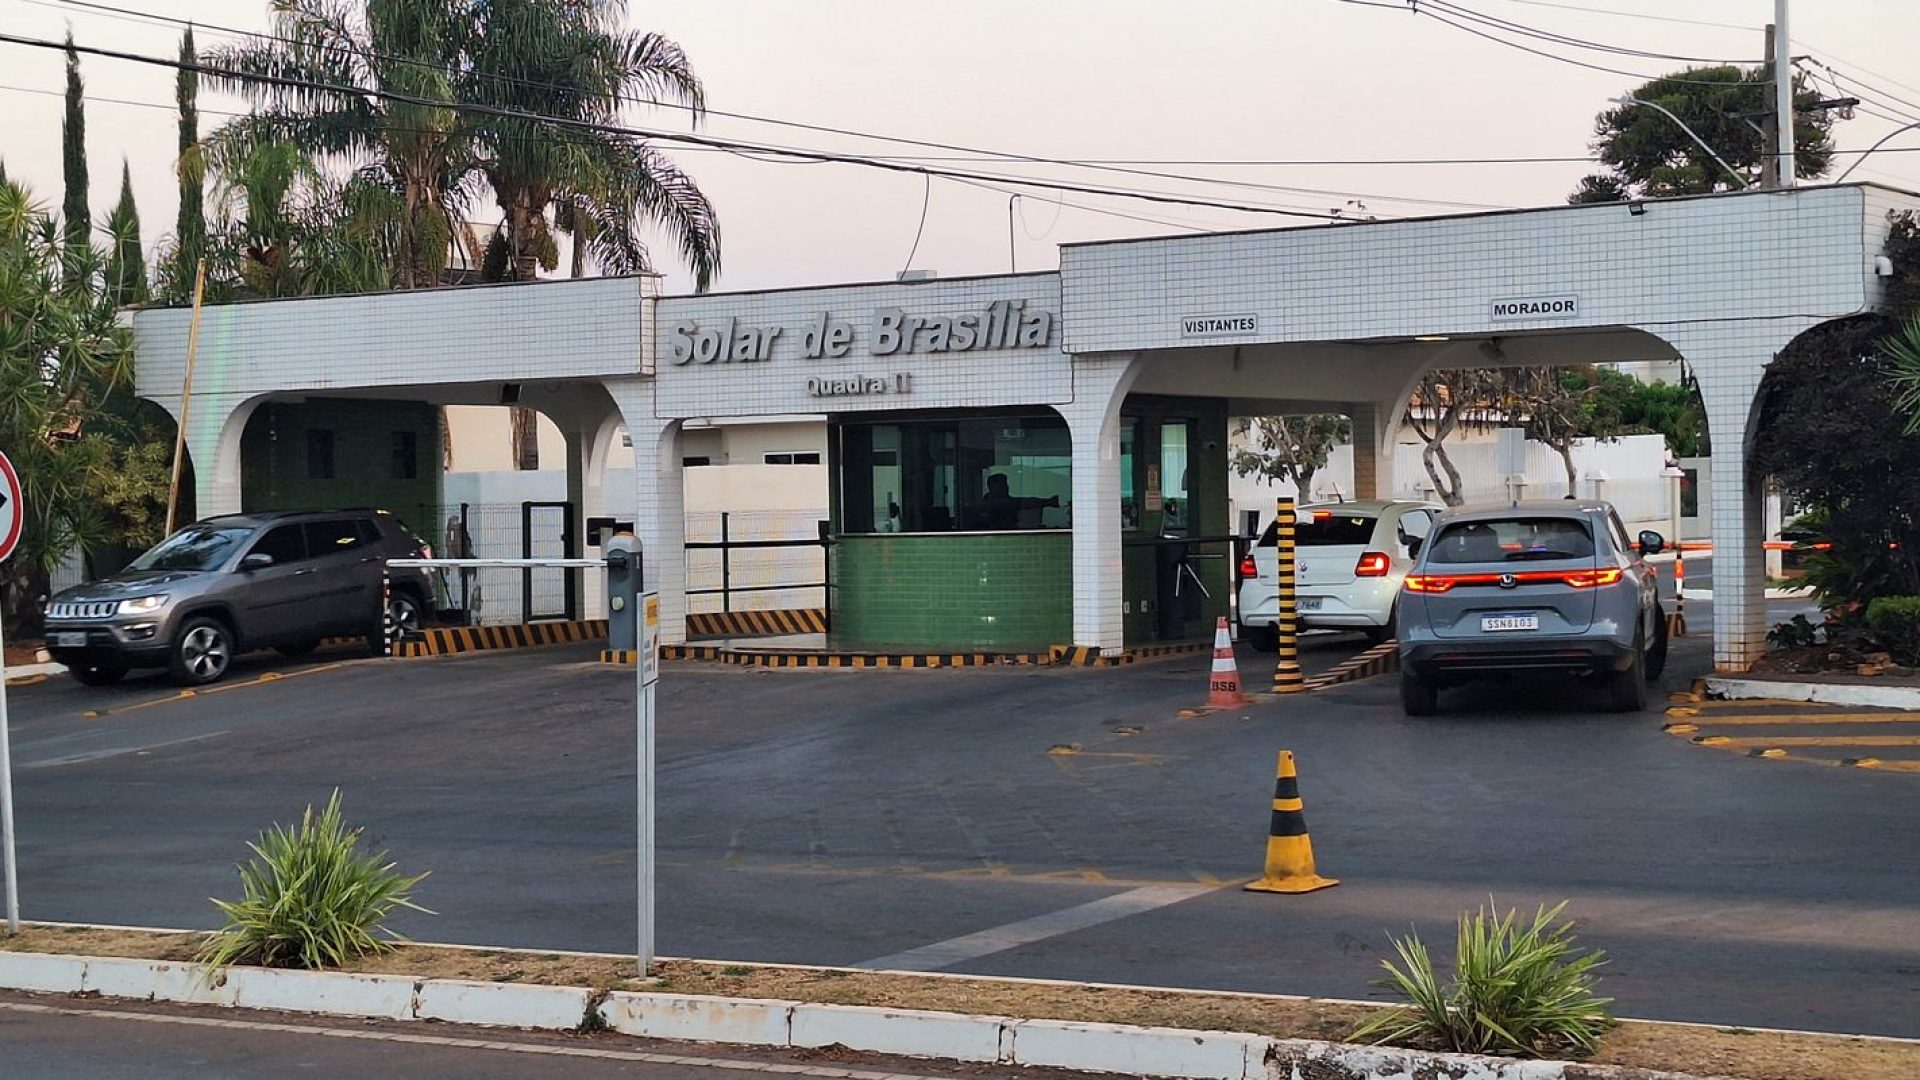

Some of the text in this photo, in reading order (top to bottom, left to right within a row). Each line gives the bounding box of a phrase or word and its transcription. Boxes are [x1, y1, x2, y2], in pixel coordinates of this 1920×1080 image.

[1494, 300, 1575, 316] MORADOR
[671, 299, 1052, 366] Solar de Brasília
[1184, 318, 1255, 333] VISITANTES
[807, 374, 887, 398] Quadra
[1211, 681, 1237, 692] BSB
